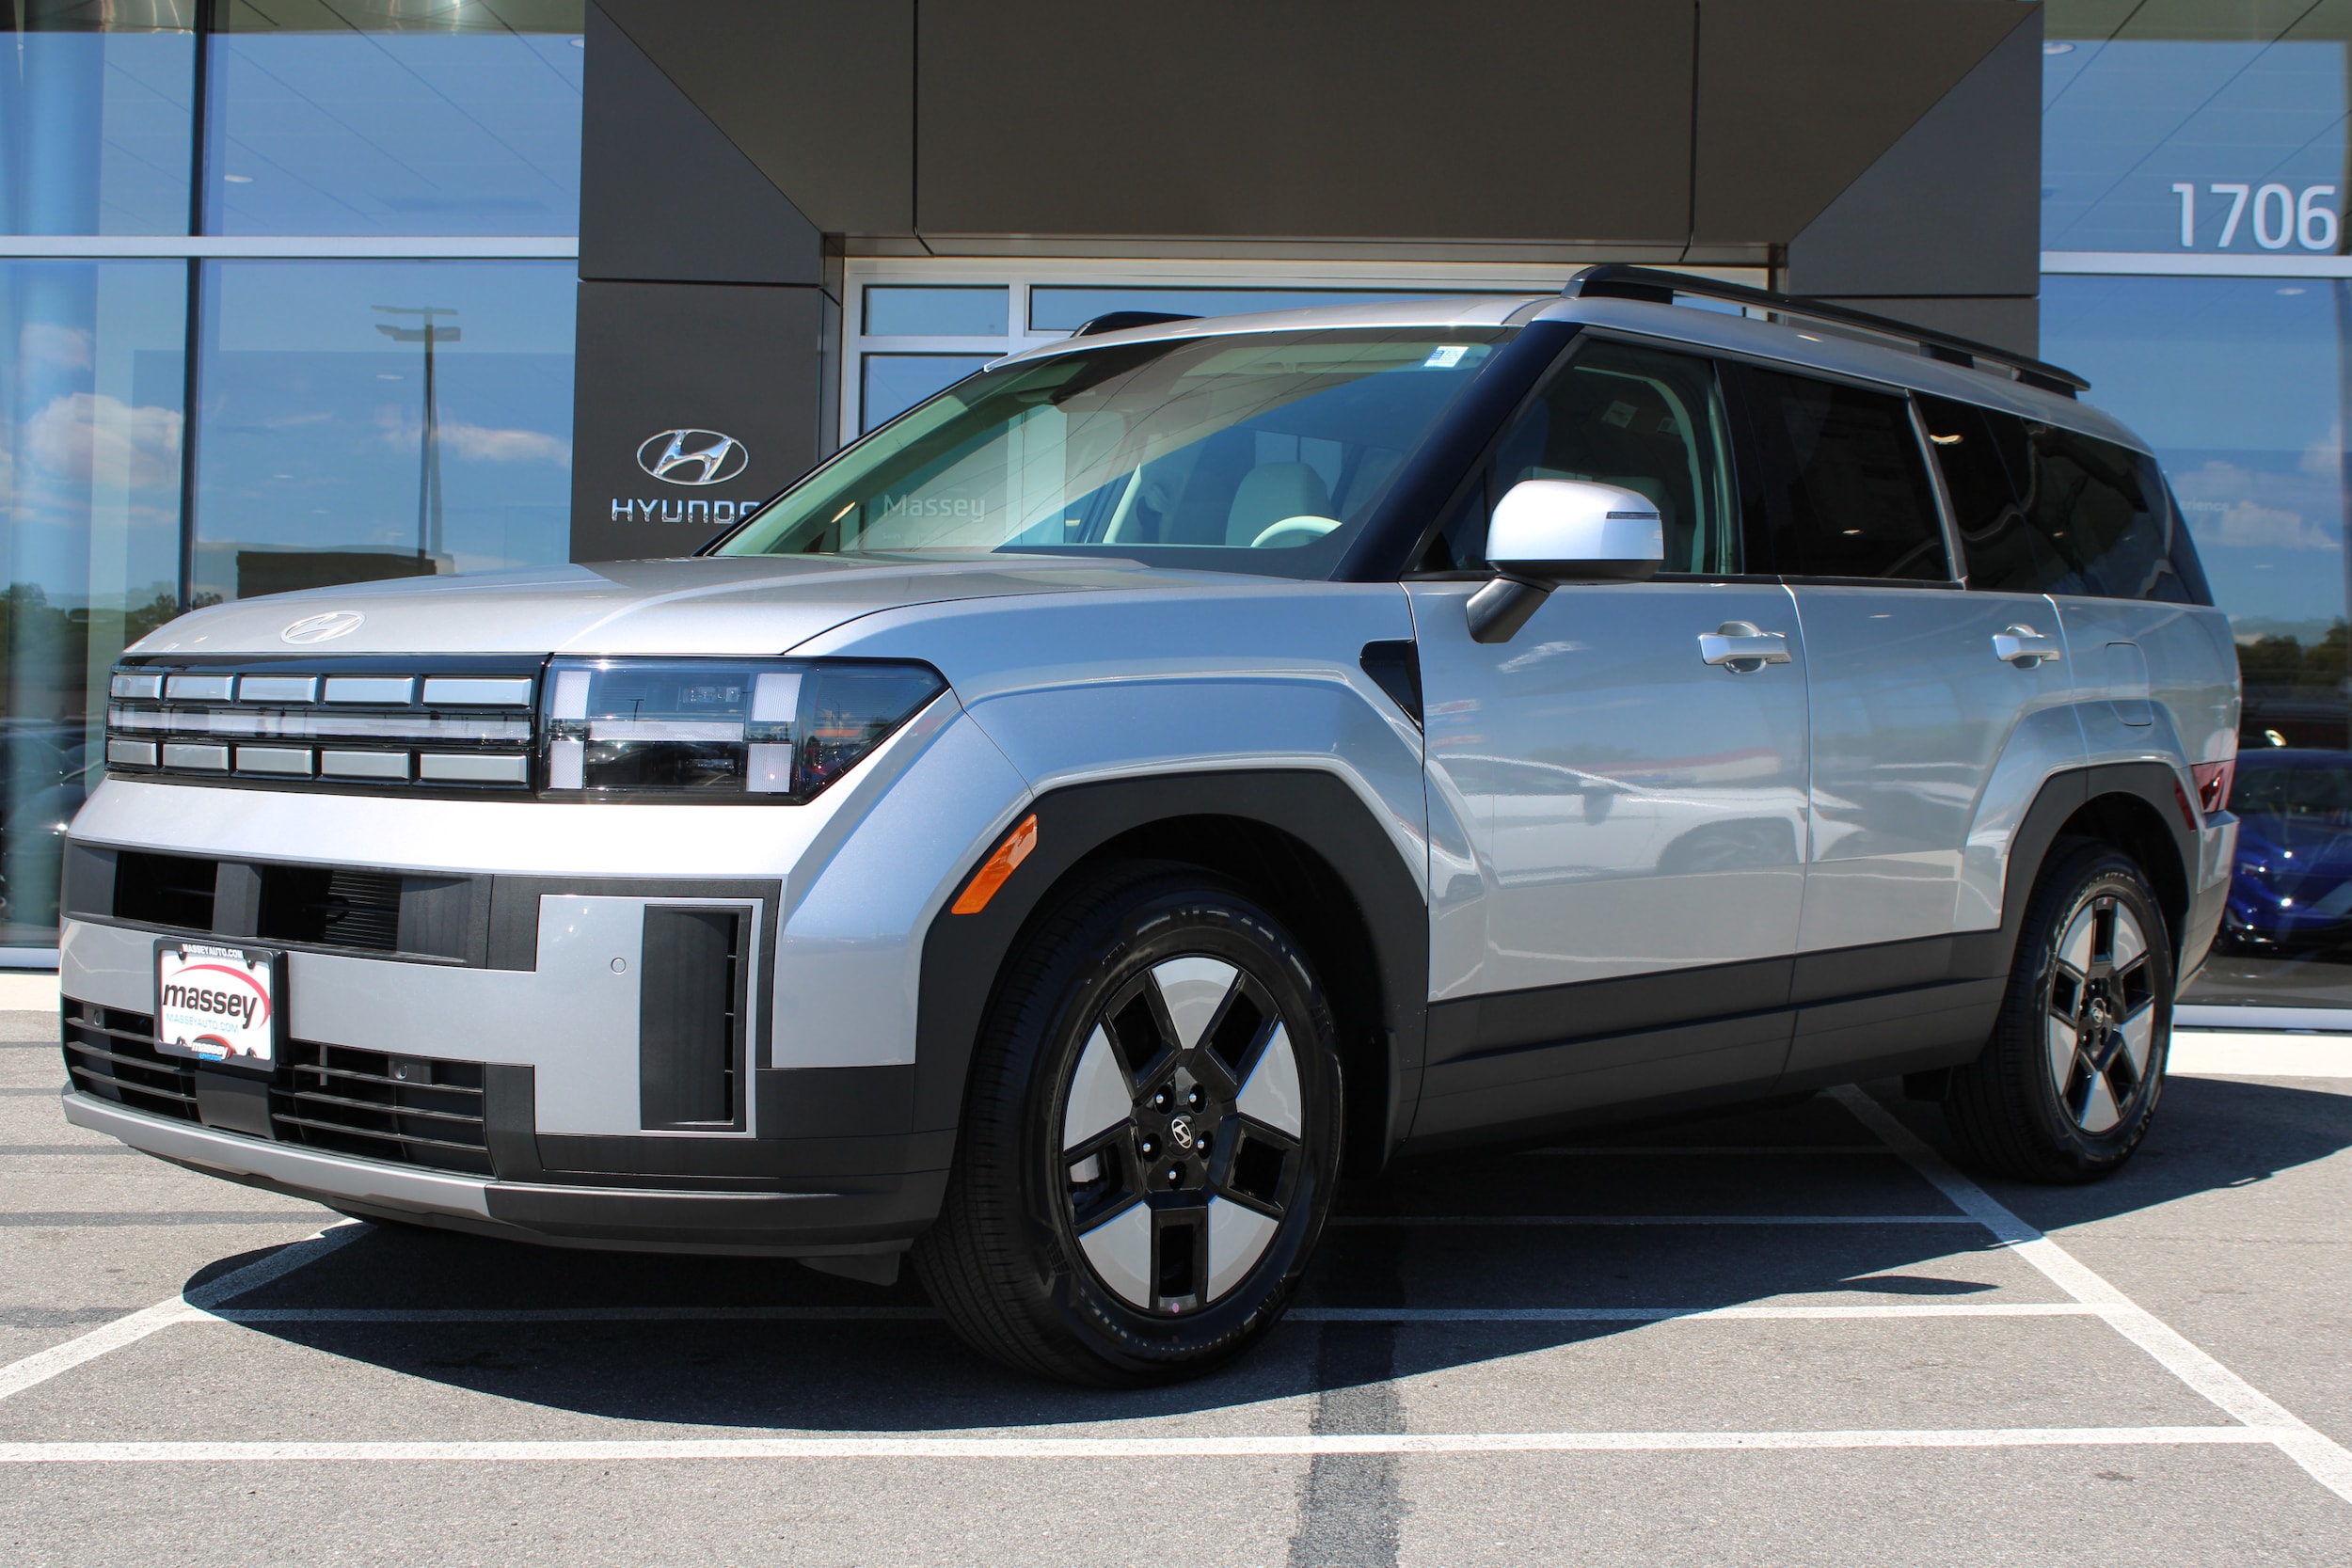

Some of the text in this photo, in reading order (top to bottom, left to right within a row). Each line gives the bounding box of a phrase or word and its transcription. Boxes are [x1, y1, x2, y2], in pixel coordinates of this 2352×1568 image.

[2171, 182, 2339, 250] 1706
[884, 494, 986, 522] Massey
[182, 943, 244, 958] MASSEYAUTO.COM
[163, 984, 258, 1029] massey
[166, 1013, 239, 1033] MASSEYAUTO.COM
[191, 1041, 229, 1060] massey
